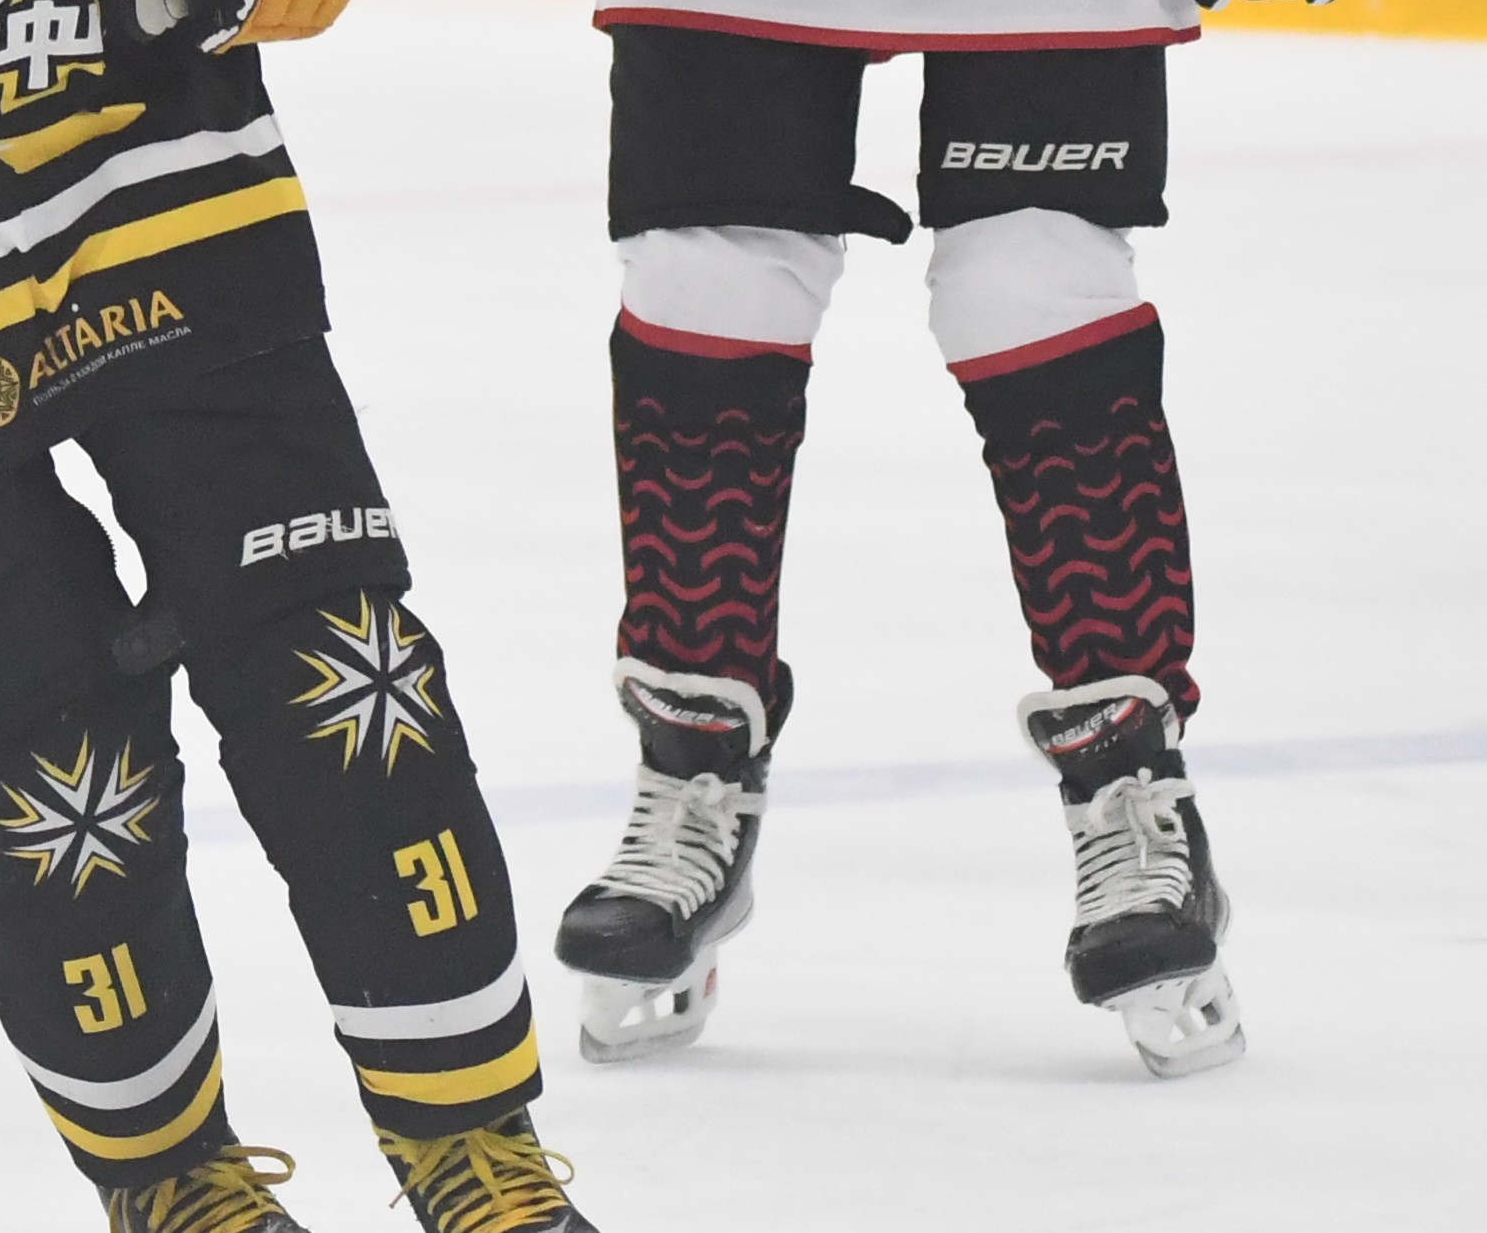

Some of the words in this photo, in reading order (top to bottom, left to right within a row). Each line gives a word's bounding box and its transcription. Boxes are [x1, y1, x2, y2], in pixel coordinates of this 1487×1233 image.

[941, 141, 1130, 172] BAUER
[28, 289, 185, 390] ALTARIA
[107, 339, 147, 361] КАПЛЕ
[148, 325, 193, 346] МАСЛА
[393, 828, 479, 938] 31
[62, 942, 148, 1035] 31
